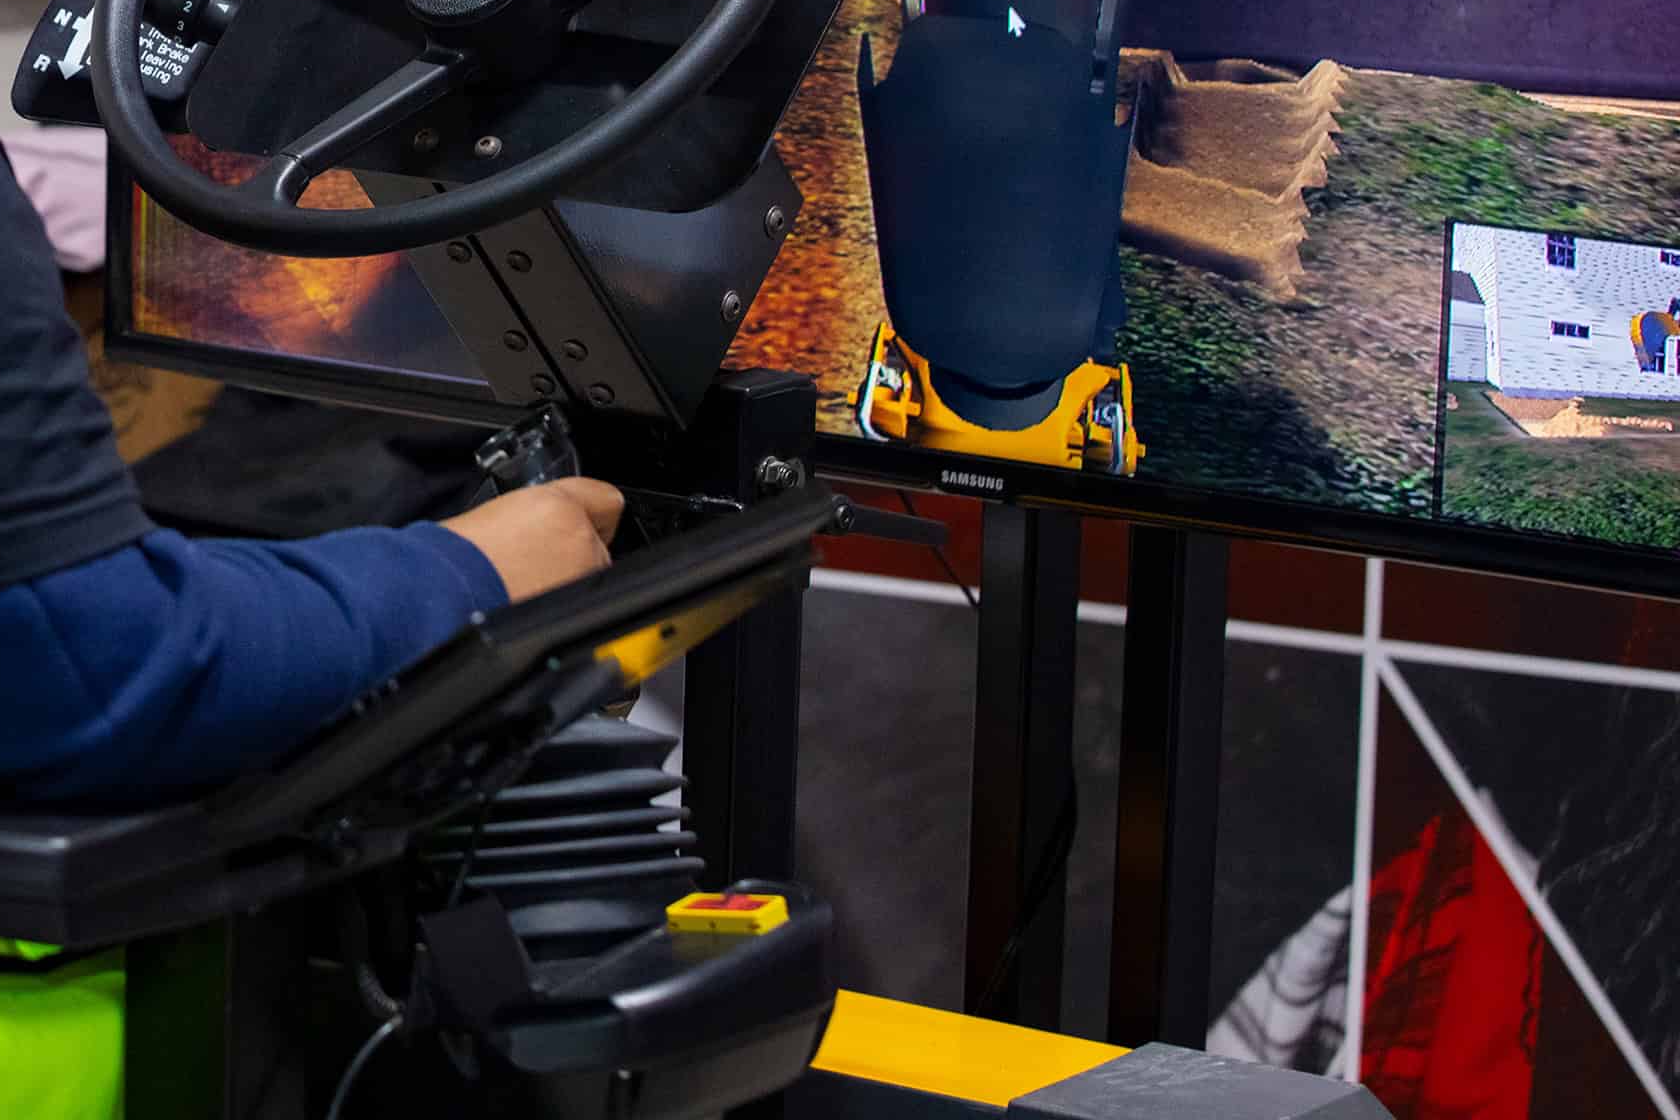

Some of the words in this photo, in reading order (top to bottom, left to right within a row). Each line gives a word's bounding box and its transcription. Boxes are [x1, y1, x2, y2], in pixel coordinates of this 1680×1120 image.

[53, 8, 73, 27] N
[32, 53, 51, 72] R
[156, 43, 190, 63] Brake
[140, 50, 184, 77] leaving
[941, 469, 1004, 491] SAMSUNG
